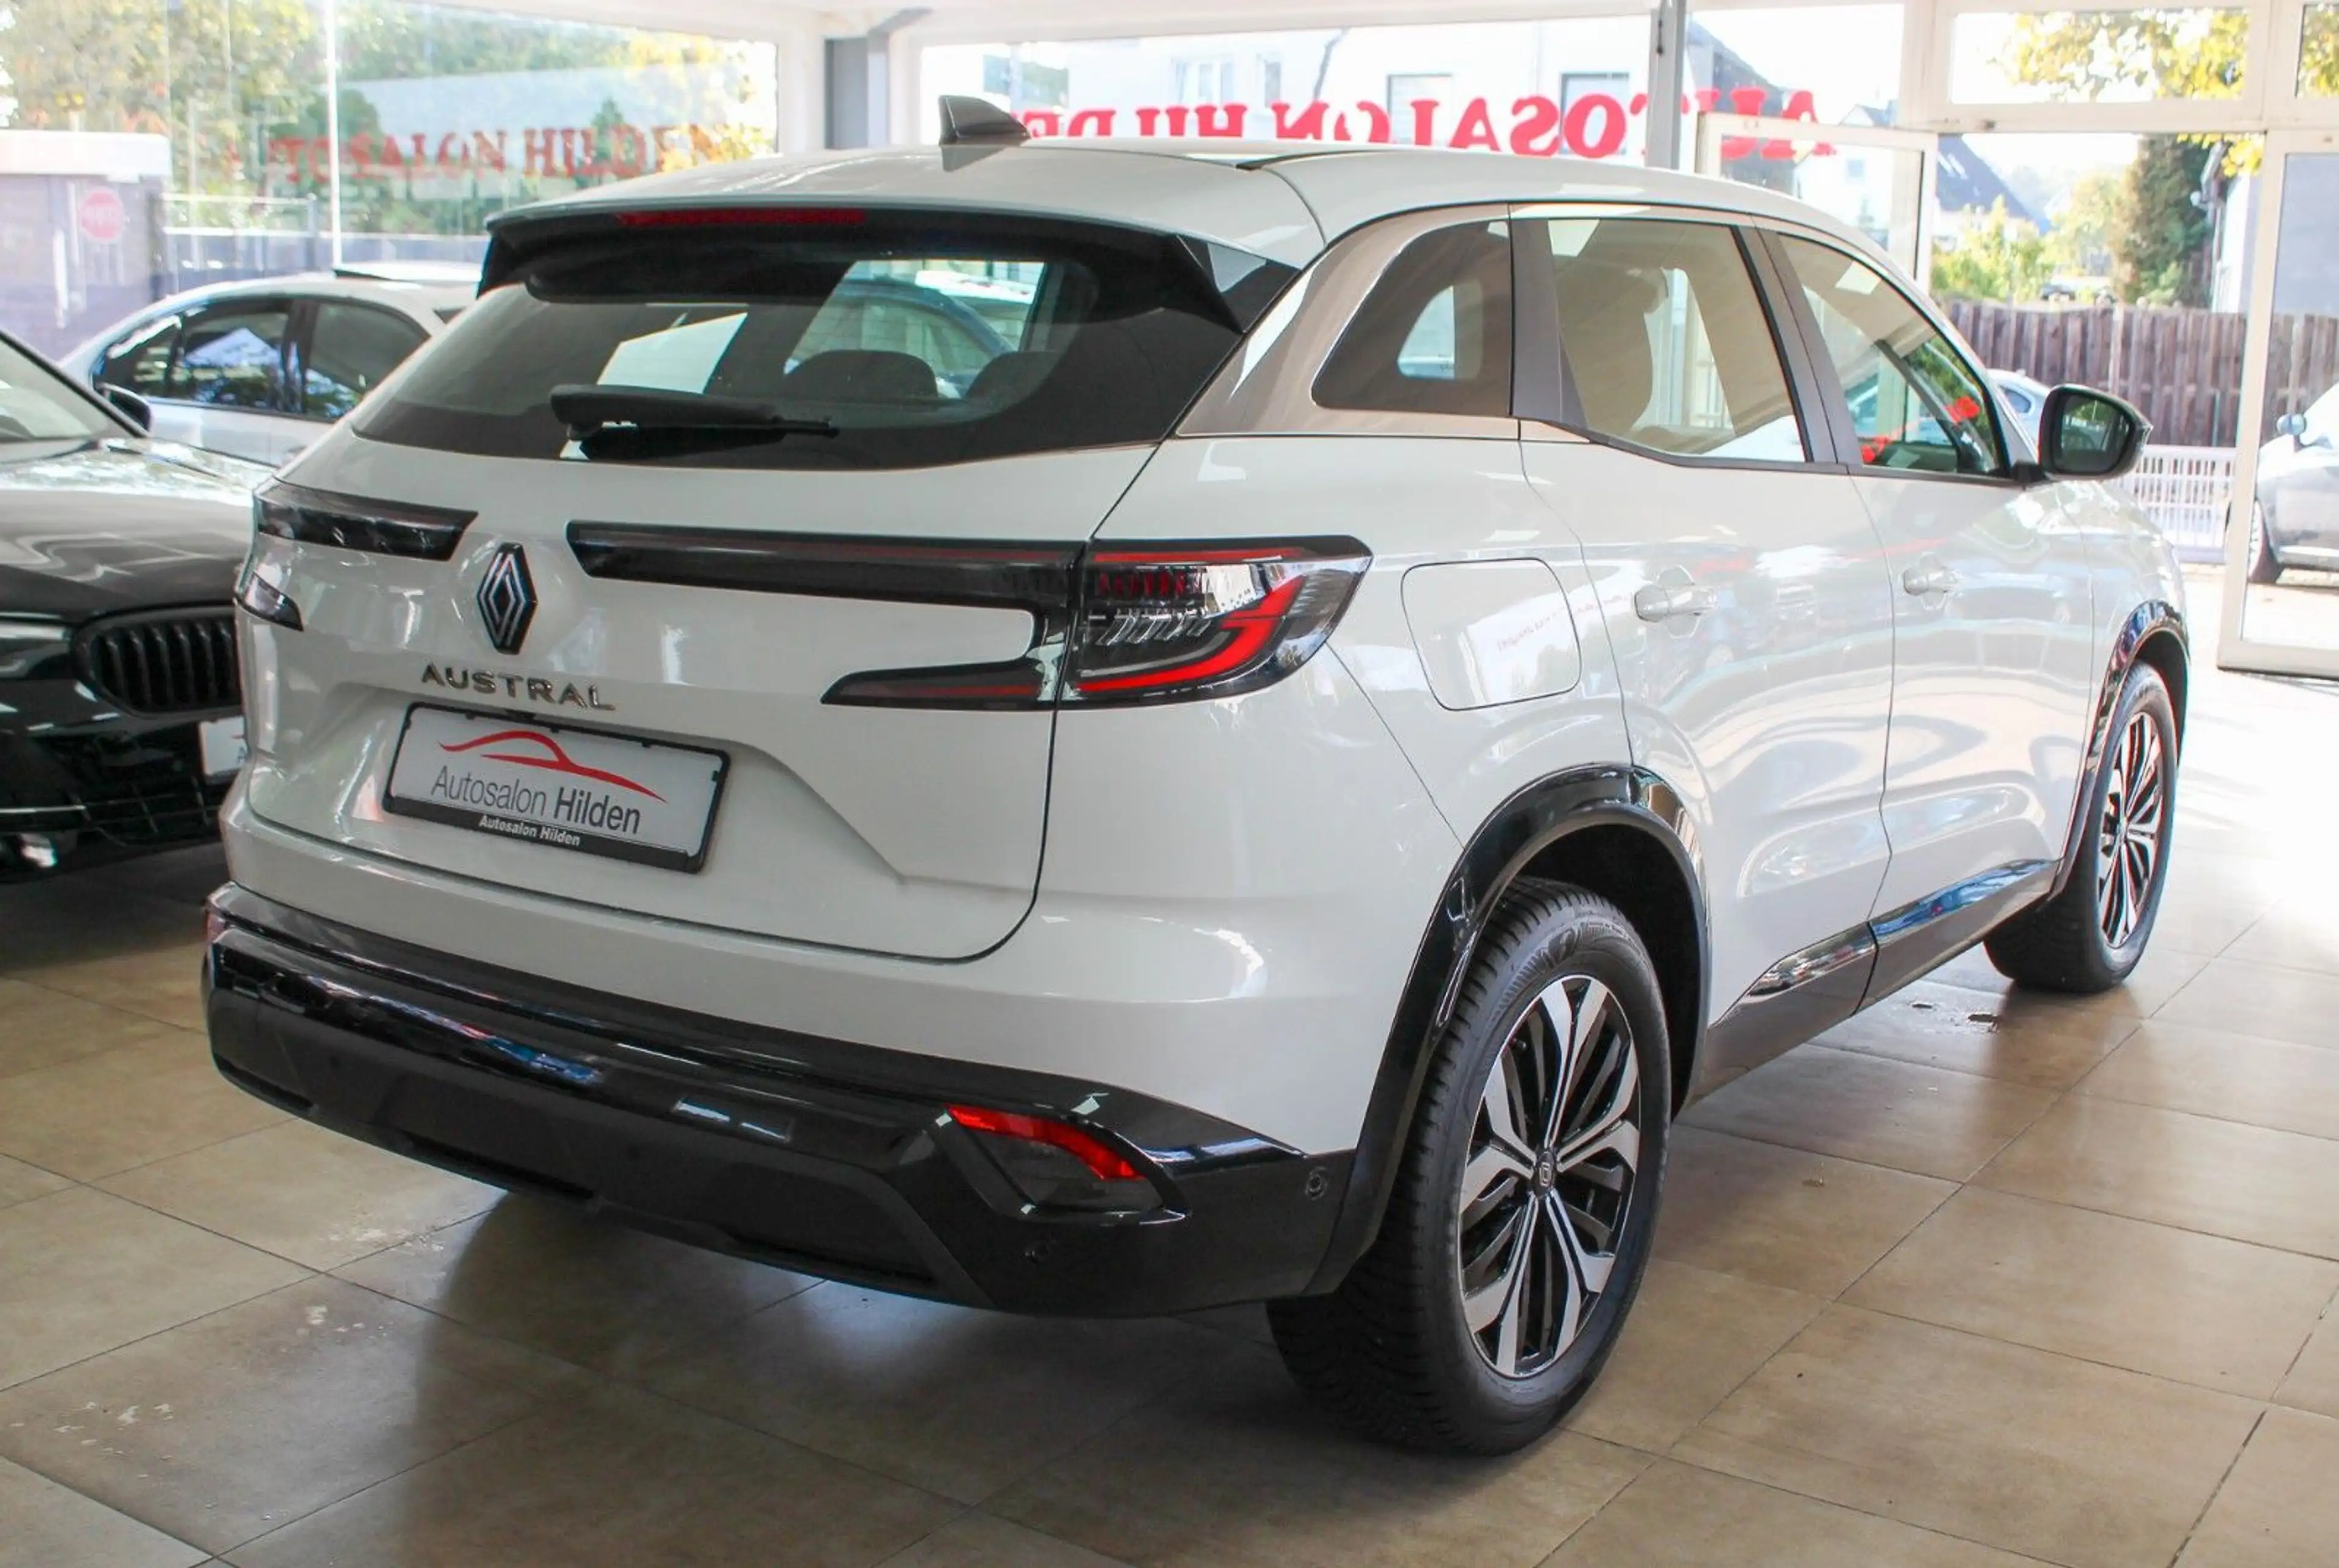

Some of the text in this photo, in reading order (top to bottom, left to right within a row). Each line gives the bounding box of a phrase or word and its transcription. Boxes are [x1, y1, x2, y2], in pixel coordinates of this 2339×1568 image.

[422, 662, 616, 711] AUSTRAL
[431, 765, 641, 835] Autosalon Hilden
[479, 814, 581, 846] Autosalon Hilden
